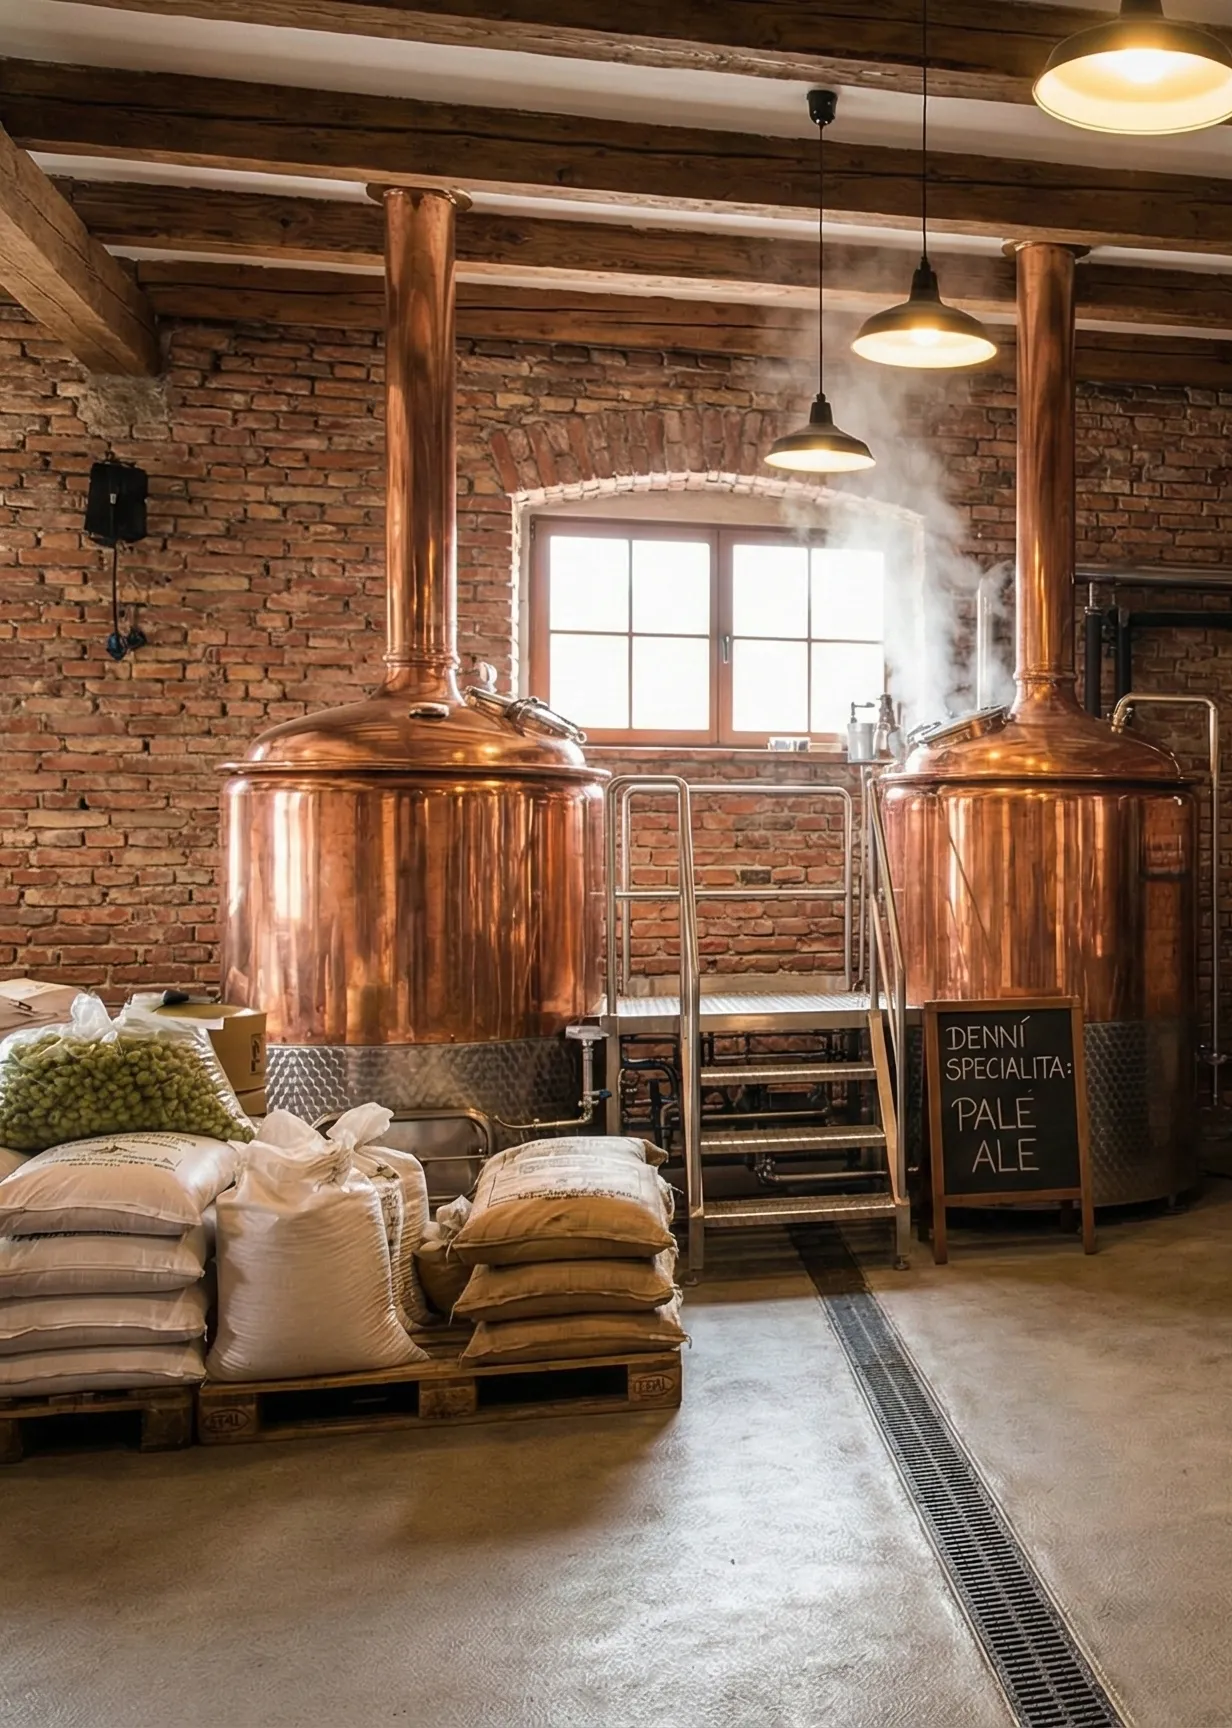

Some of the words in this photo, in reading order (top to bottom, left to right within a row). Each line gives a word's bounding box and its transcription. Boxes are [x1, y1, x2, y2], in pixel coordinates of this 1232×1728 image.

[946, 1015, 1031, 1050] DENNÍ
[946, 1056, 1072, 1081] SPECIALITA:
[972, 1139, 1040, 1173] ALE
